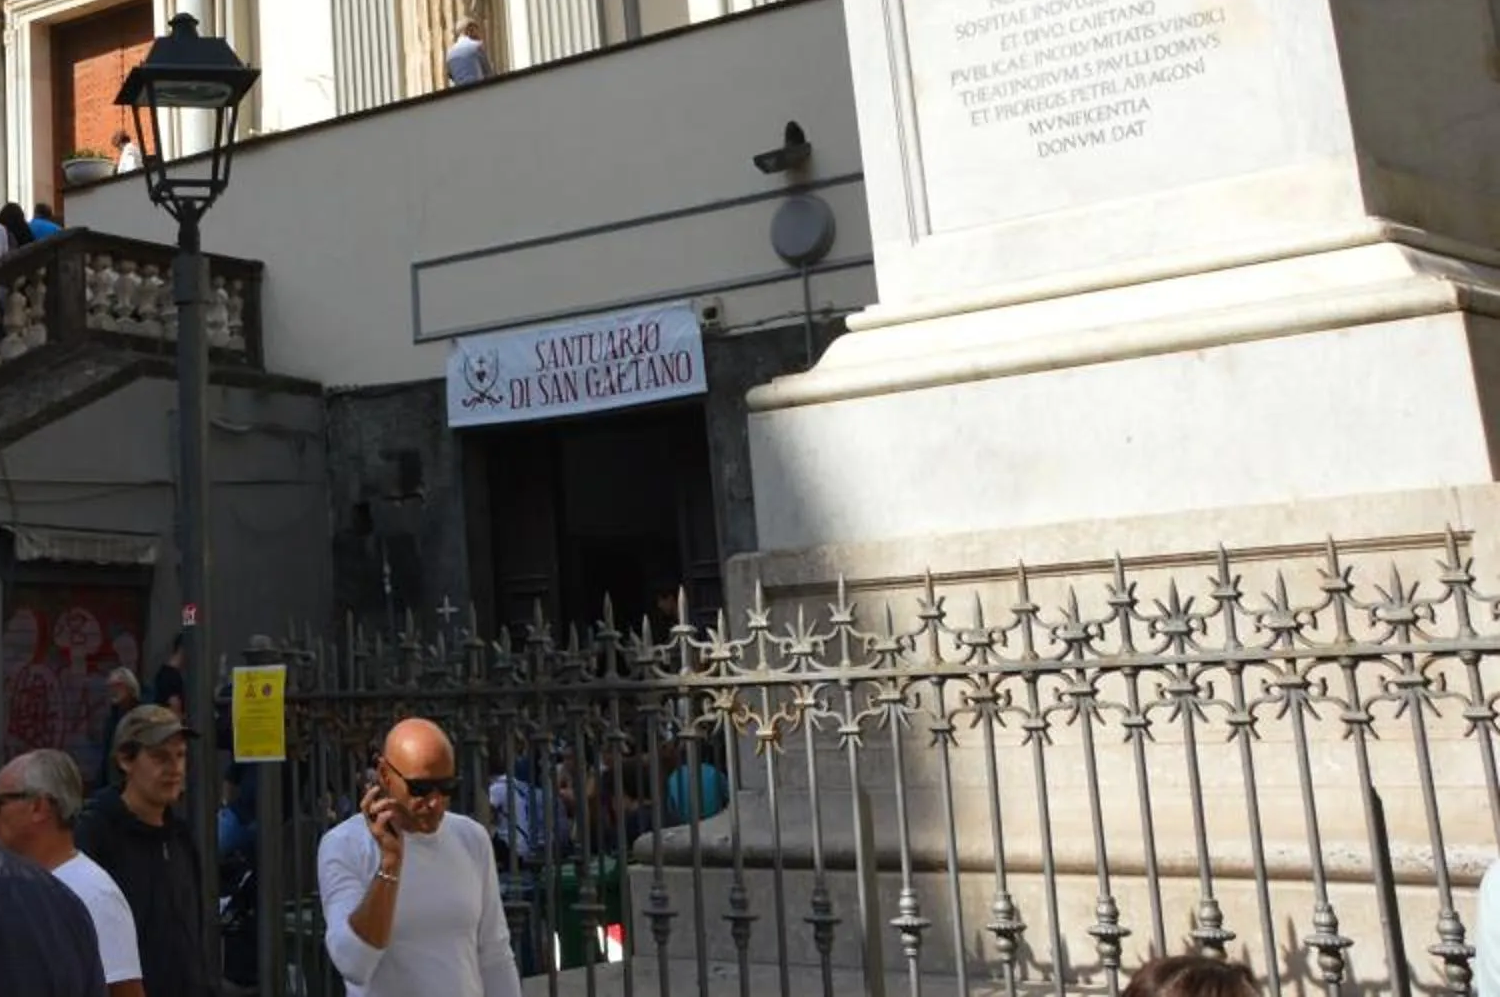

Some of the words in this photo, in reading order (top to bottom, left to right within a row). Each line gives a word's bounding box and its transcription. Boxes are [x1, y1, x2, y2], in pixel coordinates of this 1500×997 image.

[947, 50, 1031, 89] PVBLICAE
[1031, 18, 1156, 69] INCOLVMITATIS
[1158, 2, 1227, 39] VINDICI
[952, 5, 1027, 42] SOSPITAE
[1021, 19, 1065, 47] DIVO
[958, 60, 1081, 110] THEATINORVM
[1152, 28, 1222, 64] DOMVS
[992, 88, 1068, 124] PROREGIS
[1067, 76, 1118, 106] PETRI
[1120, 54, 1207, 95] ARAGONI
[1026, 91, 1152, 141] MVNIFICENTIA
[1035, 125, 1106, 161] DONVM
[535, 322, 661, 373] SANTUARIO
[508, 377, 532, 410] DI
[536, 370, 579, 406] SAN
[585, 350, 693, 399] GAETANO
